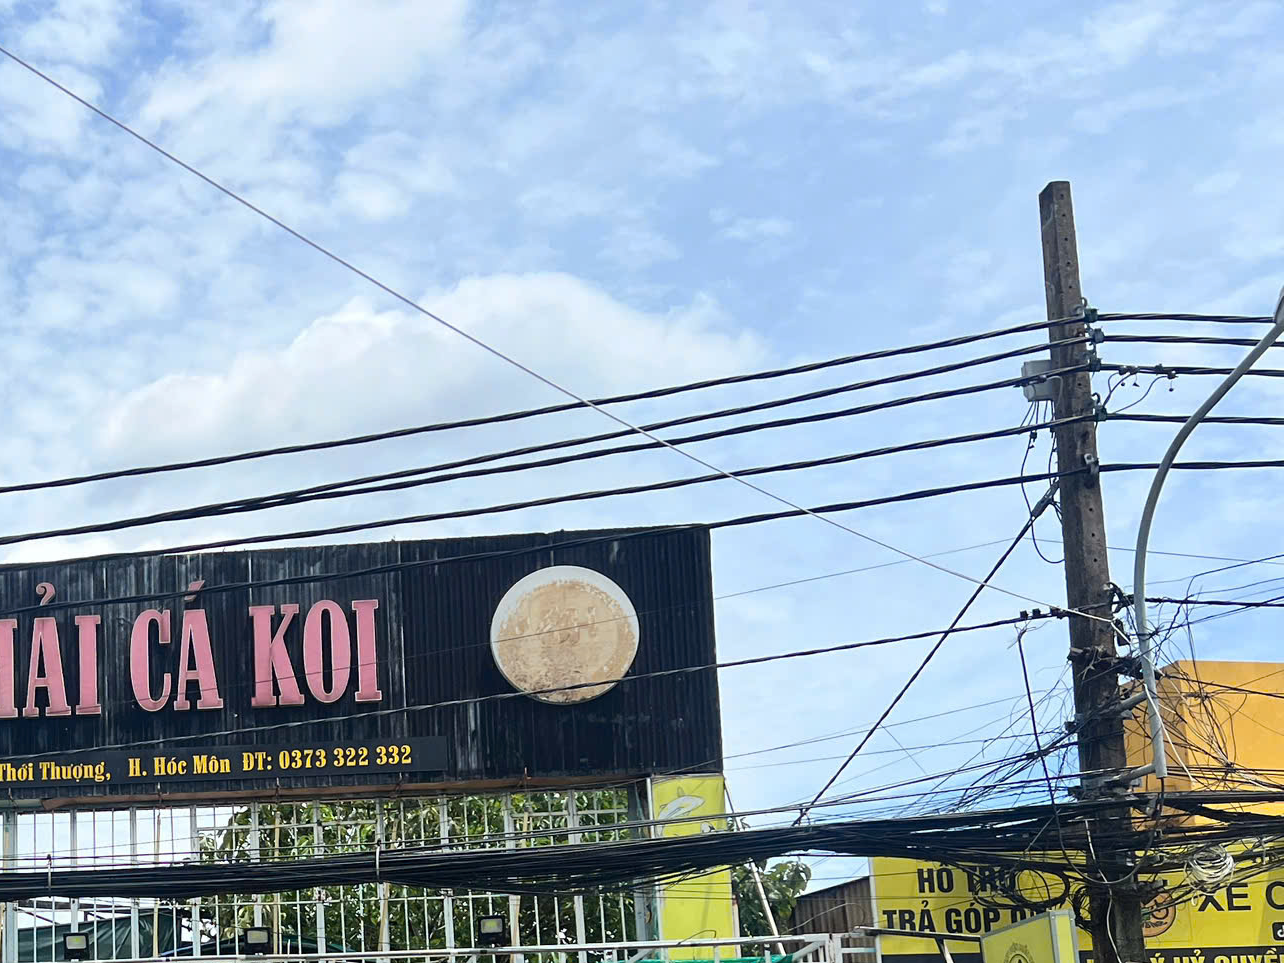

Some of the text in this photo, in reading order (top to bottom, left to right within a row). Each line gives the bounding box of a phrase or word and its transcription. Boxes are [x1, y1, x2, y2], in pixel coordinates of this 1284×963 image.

[130, 579, 224, 712] CÁ
[249, 599, 383, 709] KOI
[39, 761, 111, 783] Thượng,
[128, 758, 148, 777] H.
[153, 756, 187, 776] Hóc
[193, 755, 231, 774] Môn
[242, 751, 273, 771] ĐT:
[278, 749, 327, 769] 0373
[333, 747, 369, 767] 322
[376, 745, 412, 766] 332
[945, 902, 1001, 933] GÓP
